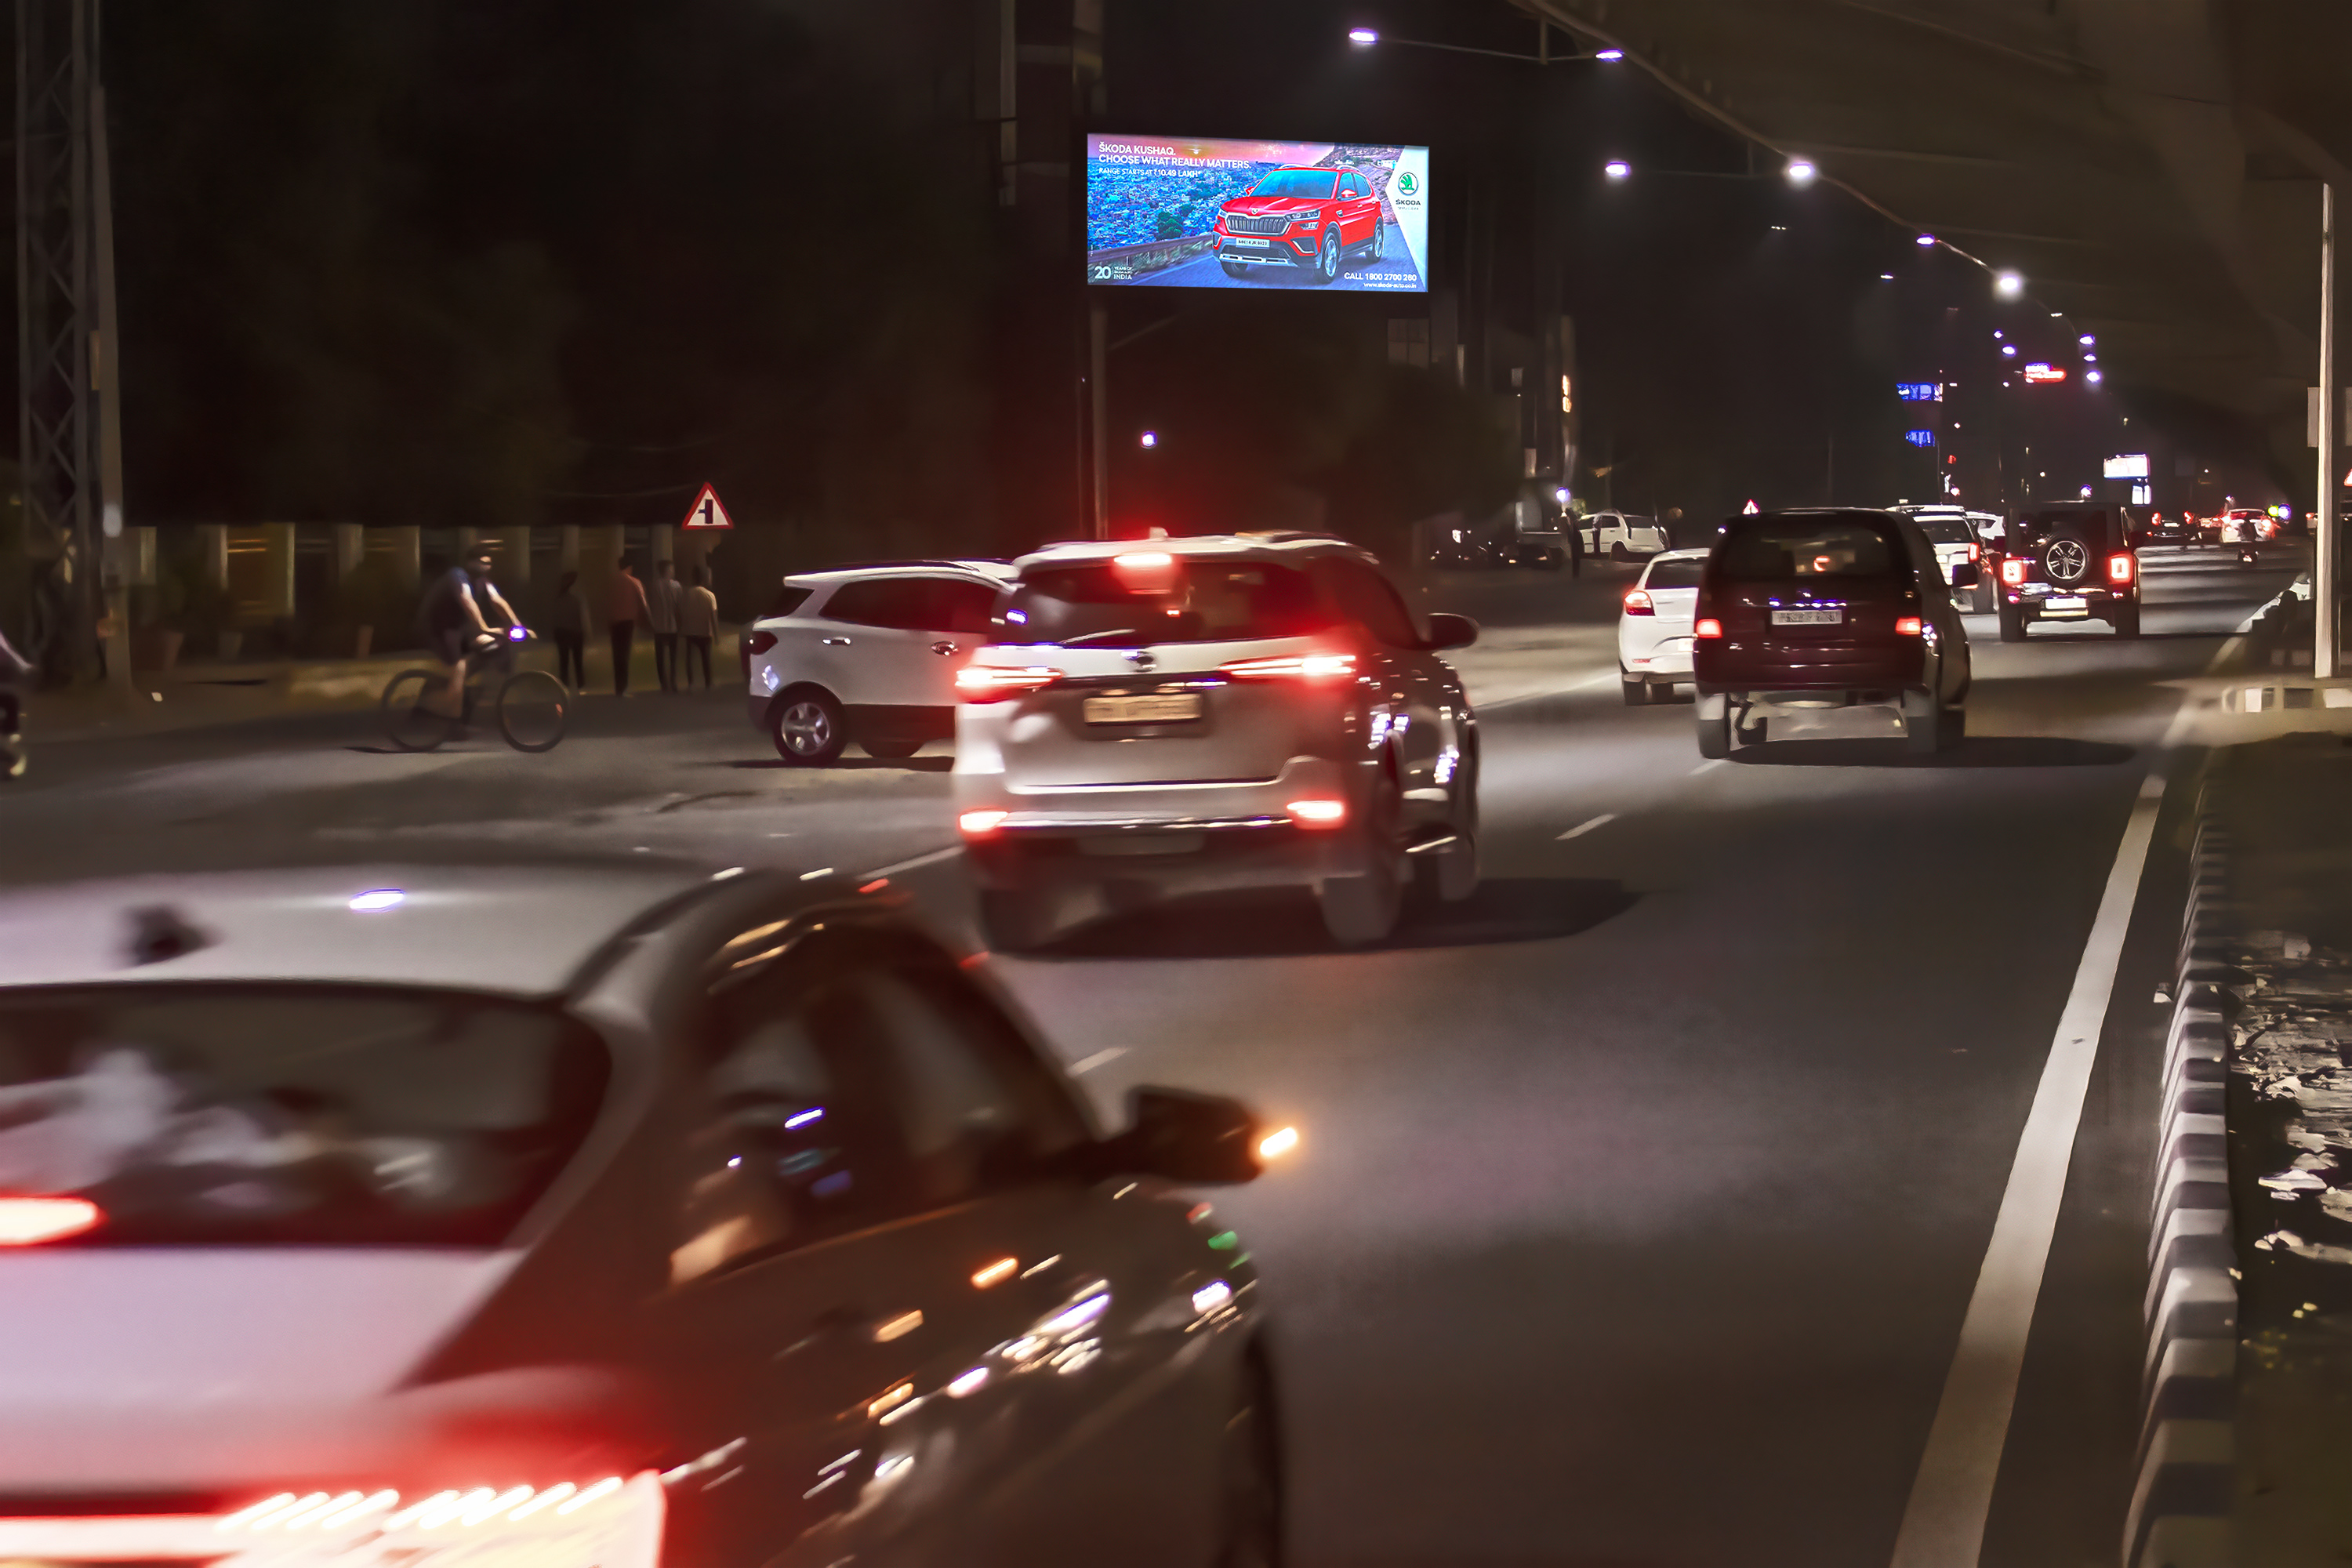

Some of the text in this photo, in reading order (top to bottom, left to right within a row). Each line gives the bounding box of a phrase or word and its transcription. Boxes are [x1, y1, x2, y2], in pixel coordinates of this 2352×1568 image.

[1098, 141, 1176, 155] ŠKODA KUSHAQ.
[1098, 154, 1251, 169] CHOOSE WHAT REALLY MATTERS.
[1094, 266, 1112, 279] 20
